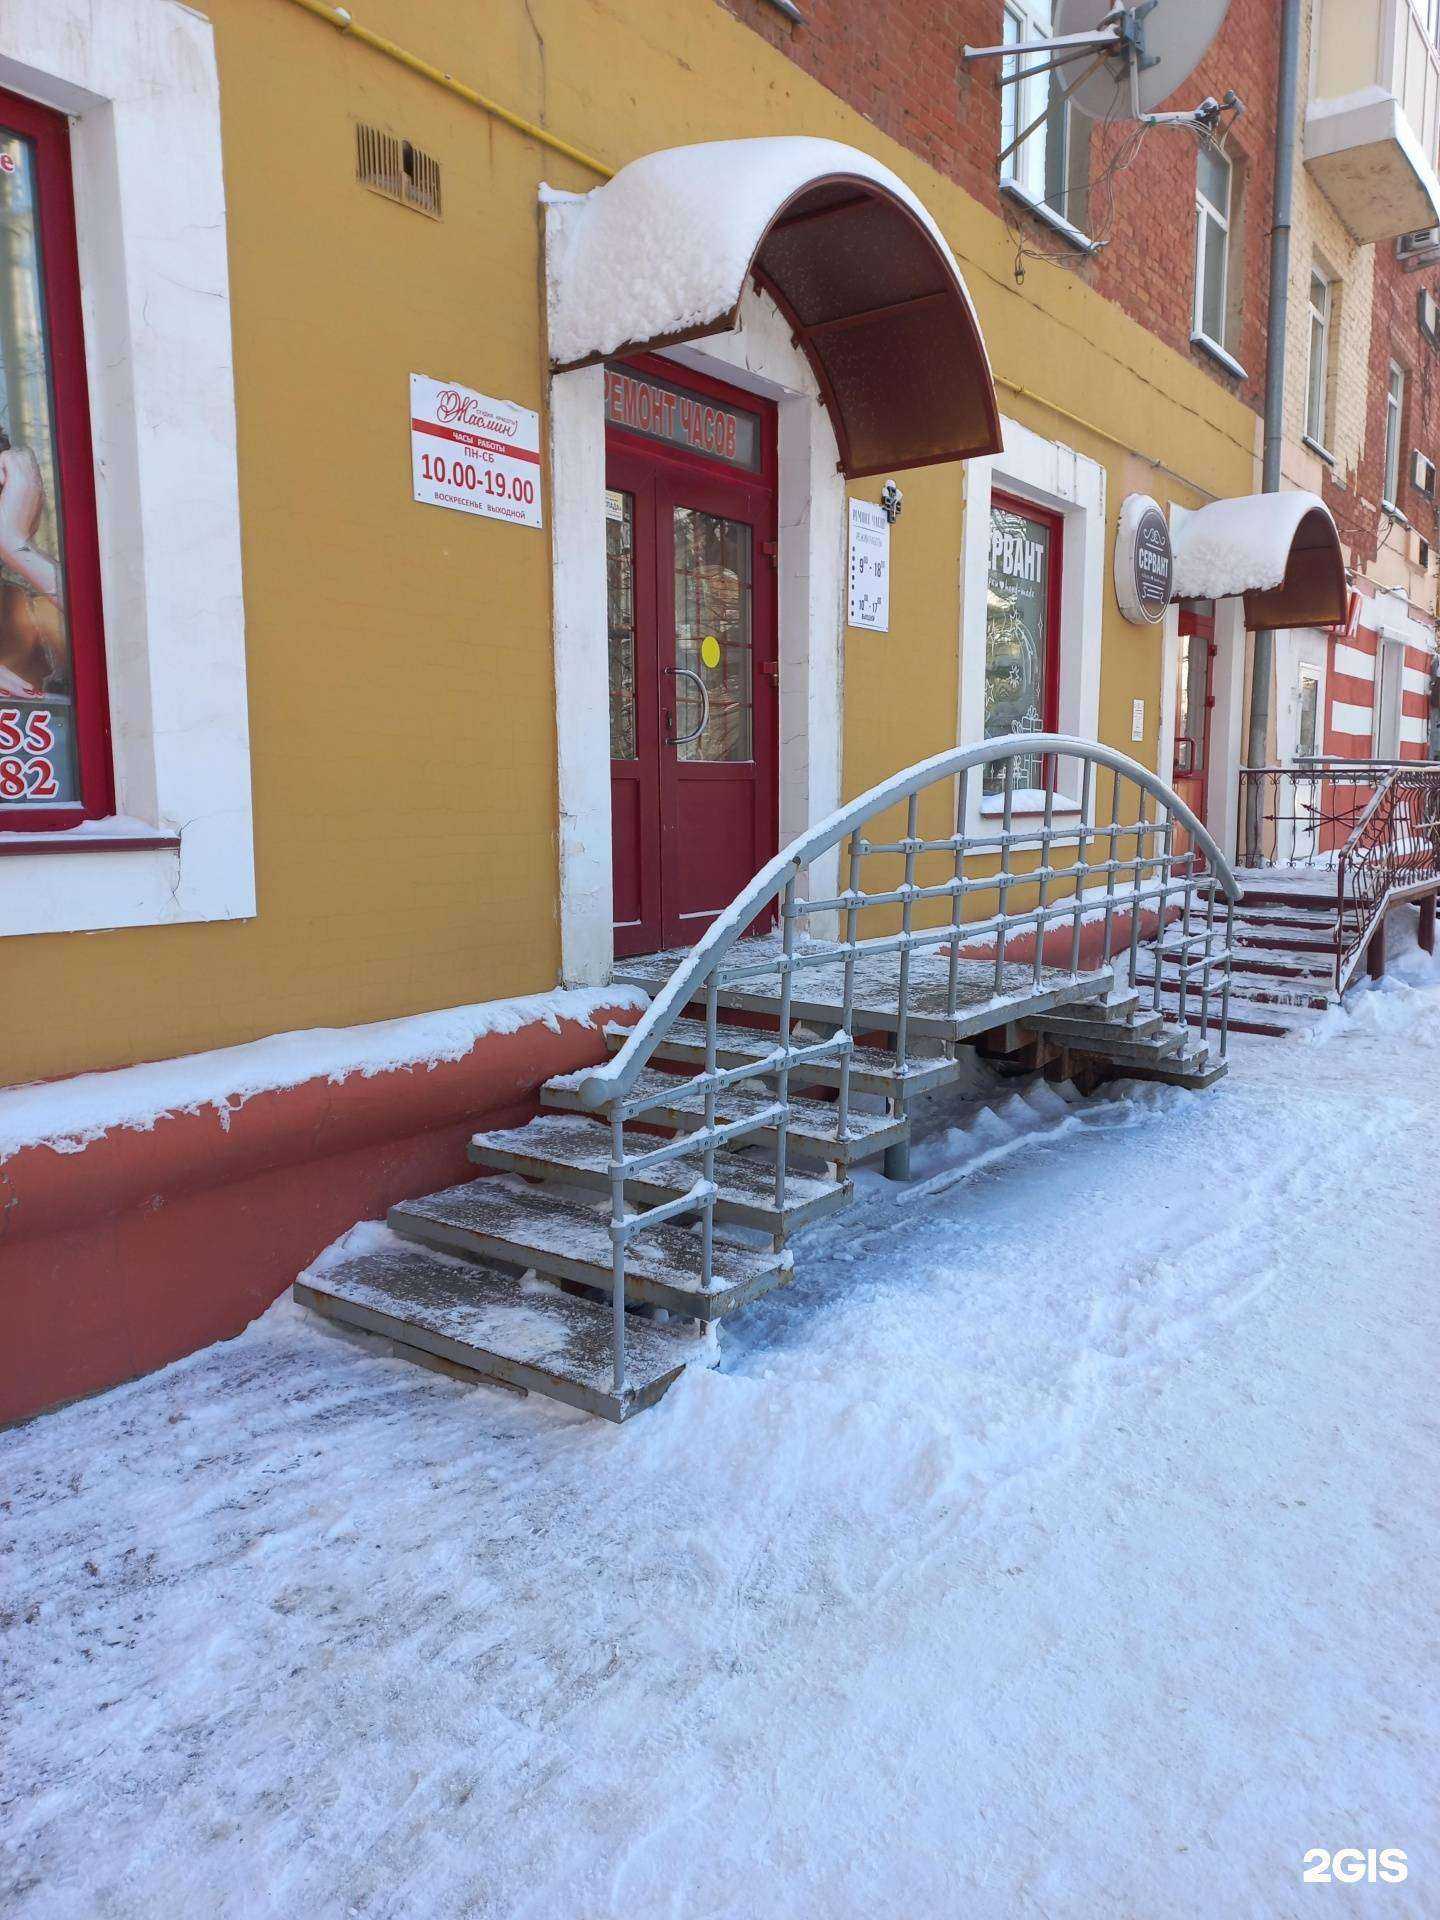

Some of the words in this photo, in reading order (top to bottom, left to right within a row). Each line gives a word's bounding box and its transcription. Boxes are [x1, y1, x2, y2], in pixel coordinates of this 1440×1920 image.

[436, 390, 518, 437] Жасмин
[680, 396, 737, 460] ЧАСОВ
[452, 431, 474, 445] ЧАСЫ
[477, 438, 506, 453] РАБОТЫ
[464, 446, 495, 463] ПН-СБ
[421, 453, 534, 504] 10.00-19.00
[434, 492, 483, 510] ВОСКРЕСЕНЬЕ
[487, 504, 526, 519] ВЫХОДНОЙ
[1138, 547, 1168, 578] СЕРВАНТ
[0, 709, 54, 754] 55
[0, 756, 59, 799] 82
